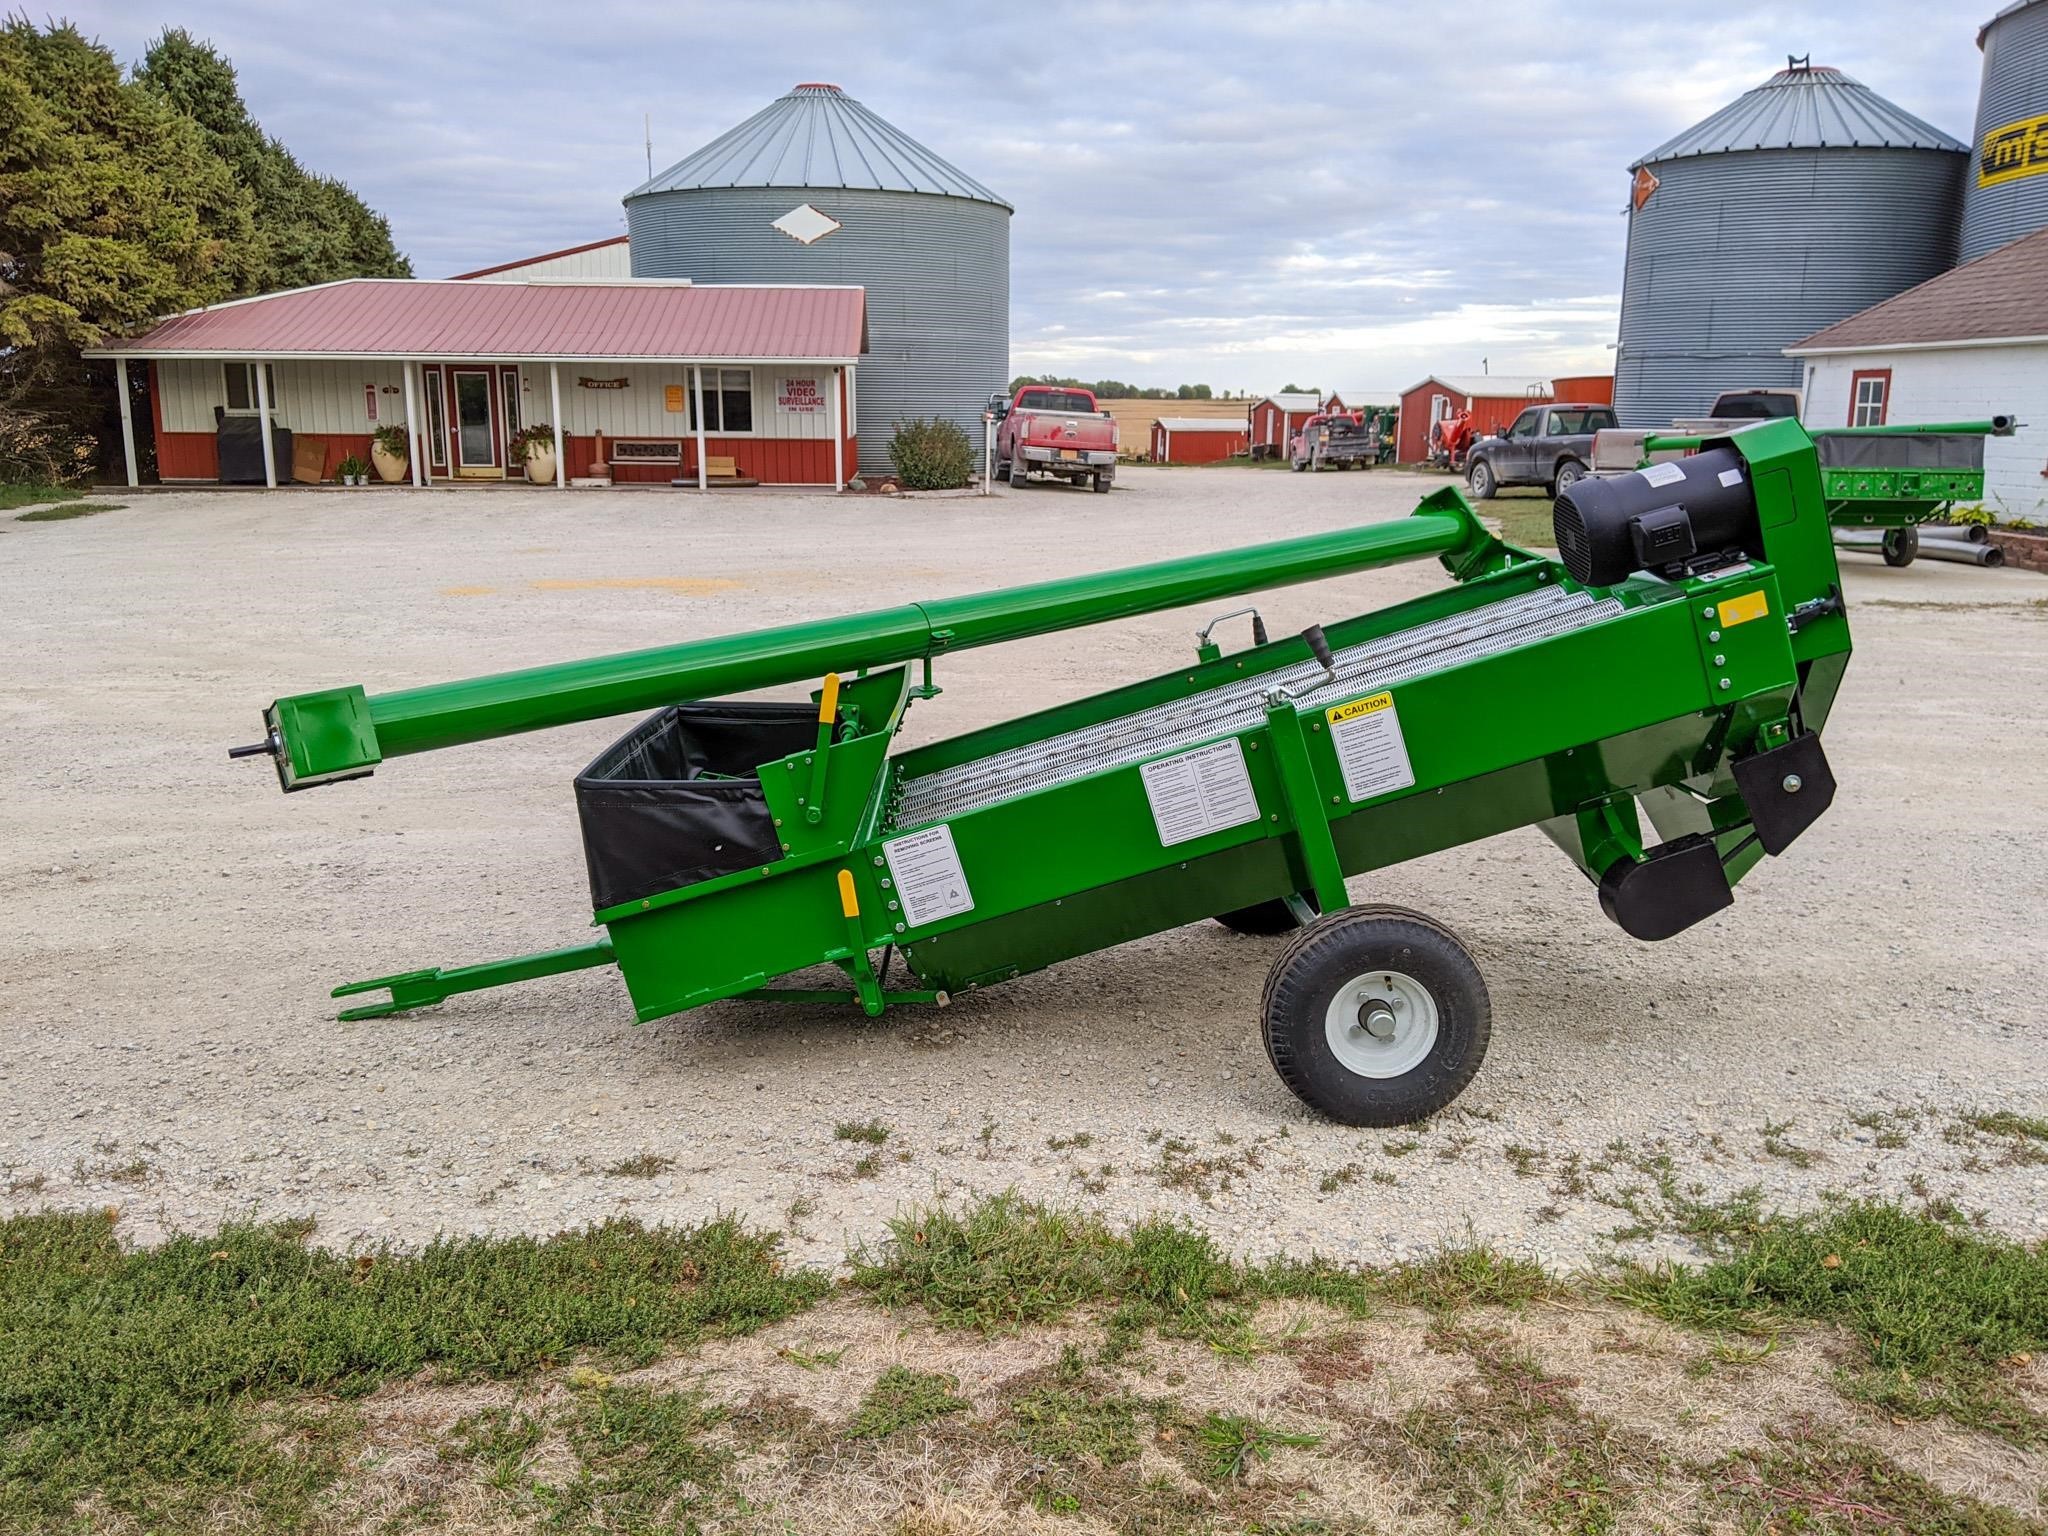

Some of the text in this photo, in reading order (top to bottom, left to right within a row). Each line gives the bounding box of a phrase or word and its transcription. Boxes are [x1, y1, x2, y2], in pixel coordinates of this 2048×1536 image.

[795, 379, 816, 387] HOUR
[778, 396, 825, 406] SURVEILLANCE
[787, 388, 816, 397] VIDEO
[1344, 697, 1388, 716] CAUTION
[1147, 742, 1233, 773] OPERATING INSTRUCTIONS
[893, 830, 940, 848] INSTRUCTIONS FOR
[894, 836, 943, 853] REMOVING SCREENS
